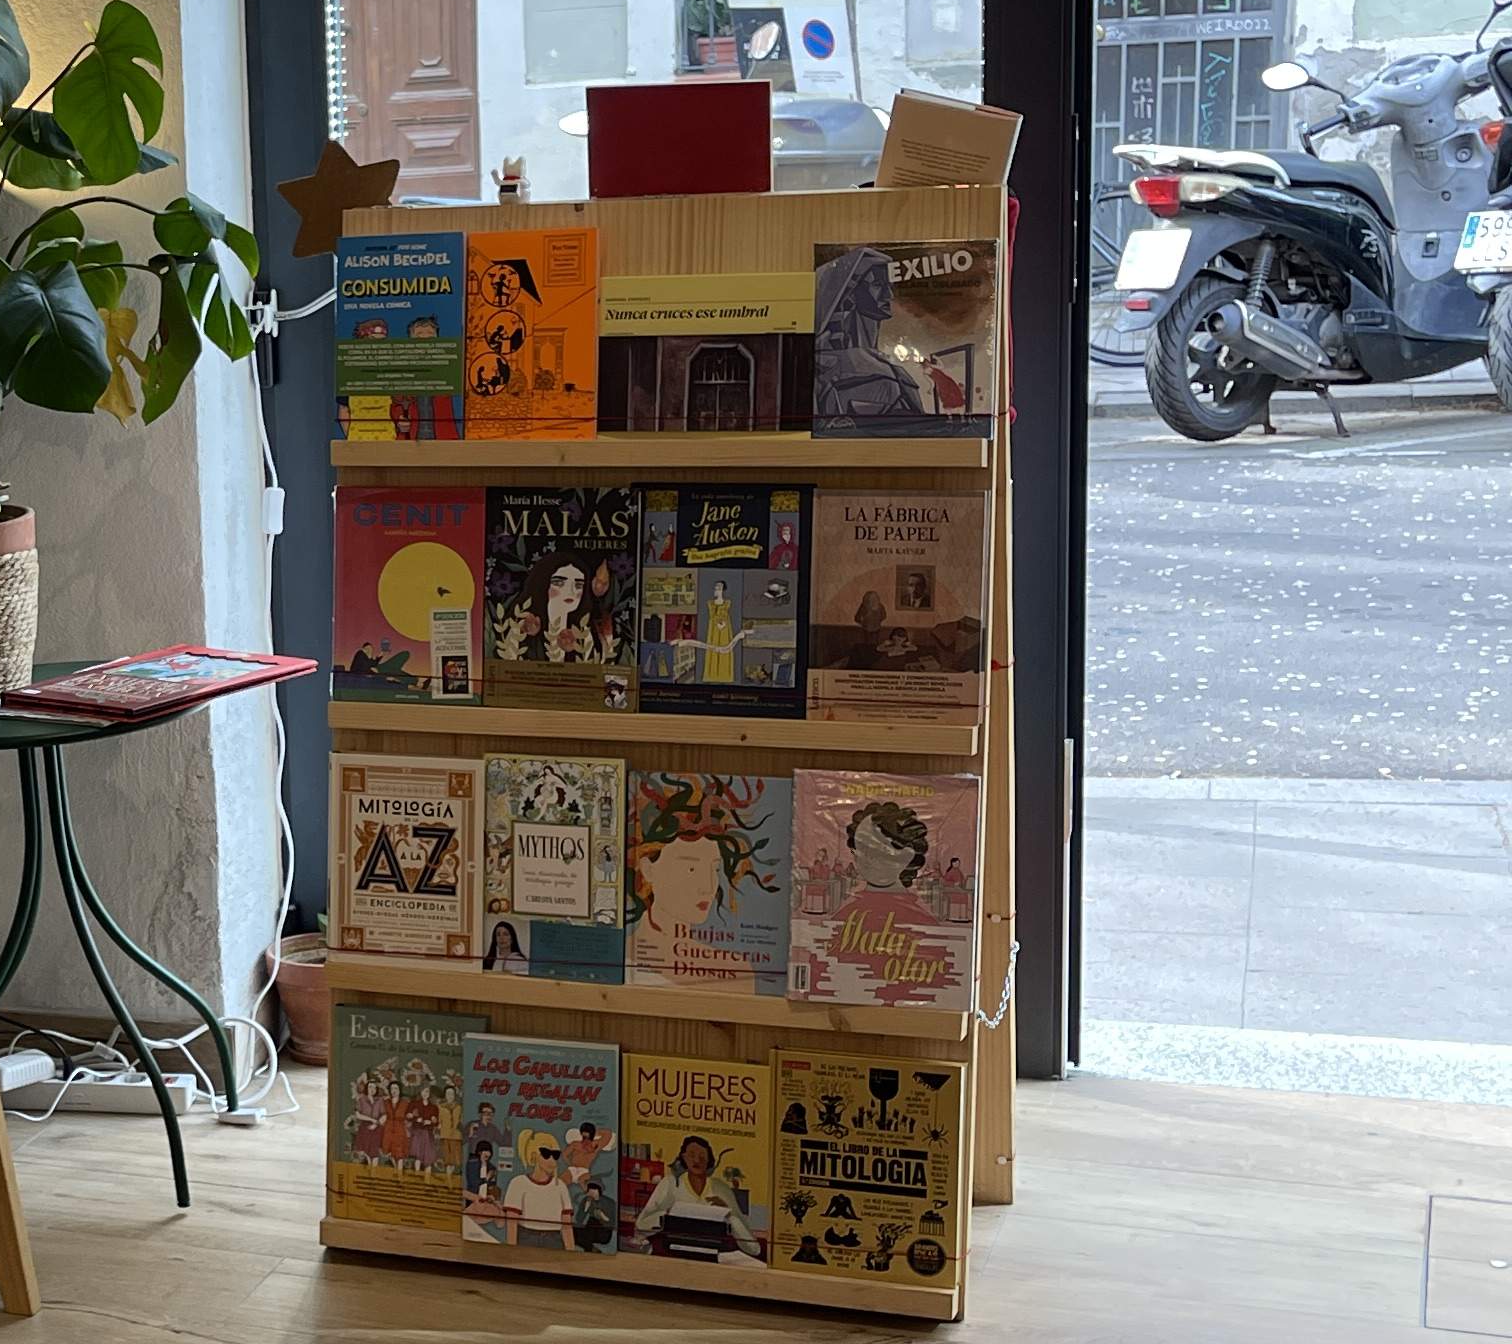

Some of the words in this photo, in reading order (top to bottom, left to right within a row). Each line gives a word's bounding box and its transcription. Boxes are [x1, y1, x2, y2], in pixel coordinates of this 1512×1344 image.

[344, 253, 389, 268] ALISON
[393, 252, 451, 266] BECHDEL
[888, 250, 973, 284] EXILIO
[342, 276, 453, 299] CONSUMIDA
[604, 308, 648, 321] Nunca
[649, 308, 693, 321] cruces
[695, 307, 718, 319] ese
[719, 305, 769, 318] umbral
[503, 495, 531, 506] María
[533, 495, 562, 505] Hesse
[353, 503, 468, 527] CENIT
[501, 509, 630, 538] MALAS
[691, 501, 742, 529] Jane
[844, 507, 867, 523] LA
[874, 503, 952, 524] FÁBRICA
[574, 539, 628, 550] MUJERES
[692, 524, 760, 547] Austen
[854, 526, 881, 540] DE
[886, 526, 940, 542] PAPEL
[358, 798, 454, 819] MITOLOGÍA
[518, 833, 586, 864] MYTHOS
[369, 898, 446, 912] ENCICLOPEDIA
[673, 922, 735, 945] Brujas
[672, 944, 771, 964] Guerreras
[884, 940, 949, 986] olor
[673, 961, 738, 981] Diosas
[473, 1052, 509, 1075] LOS
[637, 1067, 757, 1105] MUJERES
[636, 1098, 674, 1118] QUE
[677, 1103, 756, 1126] CUENTAN
[830, 1140, 840, 1151] EL
[841, 1142, 870, 1154] LIBRO
[872, 1144, 885, 1156] DE
[886, 1145, 899, 1157] LA
